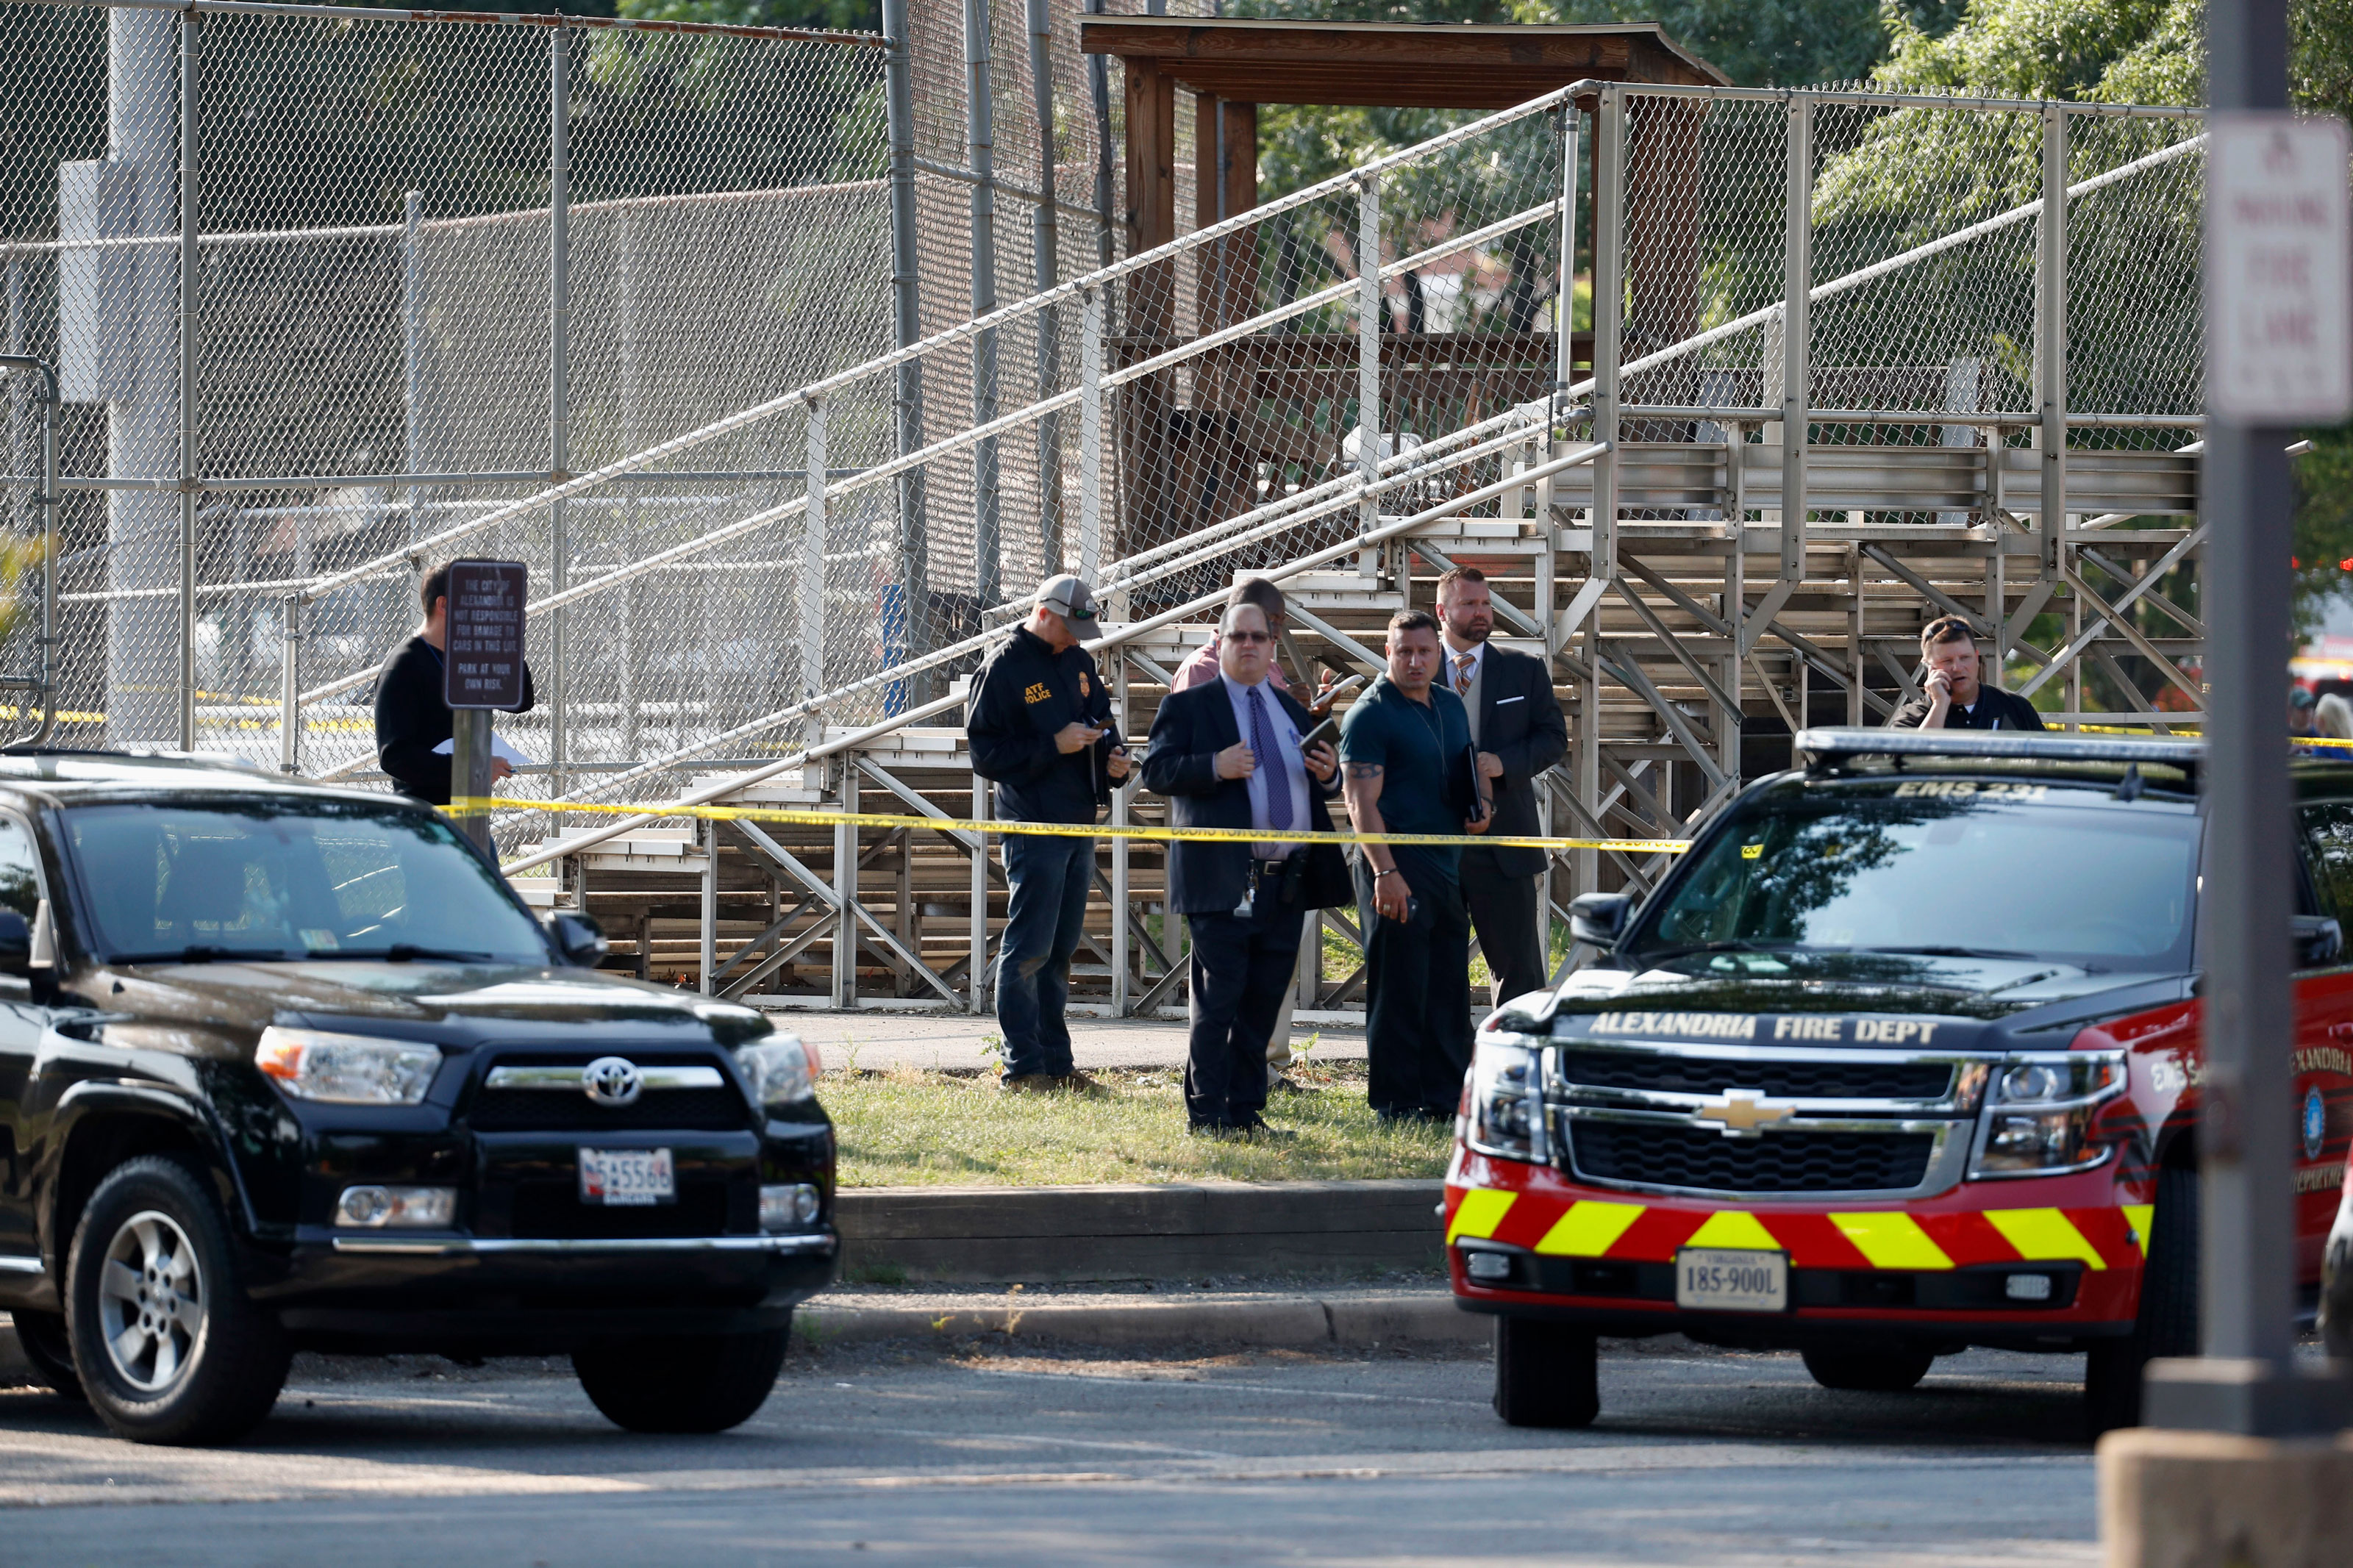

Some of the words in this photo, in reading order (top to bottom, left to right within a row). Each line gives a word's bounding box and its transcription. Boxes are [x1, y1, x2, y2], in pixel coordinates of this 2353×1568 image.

[465, 579, 479, 591] THE
[481, 579, 498, 591] CITY
[459, 595, 504, 606] ALEXANDRIA
[506, 595, 515, 607] IS
[454, 609, 468, 621] NOT
[471, 609, 518, 622] RESPONSIBLE
[457, 624, 471, 637] FOR
[473, 625, 503, 637] DAMAGE
[504, 625, 515, 637] TO
[453, 640, 473, 652] CARS
[474, 640, 482, 651] IN
[485, 640, 501, 651] THIS
[458, 663, 477, 674] PARK
[479, 663, 490, 674] AT
[492, 663, 511, 675] YOUR
[465, 678, 483, 690] OWN
[1025, 682, 1044, 696] ATF
[1024, 689, 1052, 704] POLICE
[1894, 781, 1979, 798] EMS
[1979, 783, 2049, 801] 231
[1589, 1011, 1757, 1040] ALEXANDRIA
[1774, 1016, 1843, 1041] FIRE
[1854, 1020, 1938, 1045] DEPT
[1705, 1253, 1757, 1264] VIRGINIA
[1687, 1266, 1777, 1294] 185-900L
